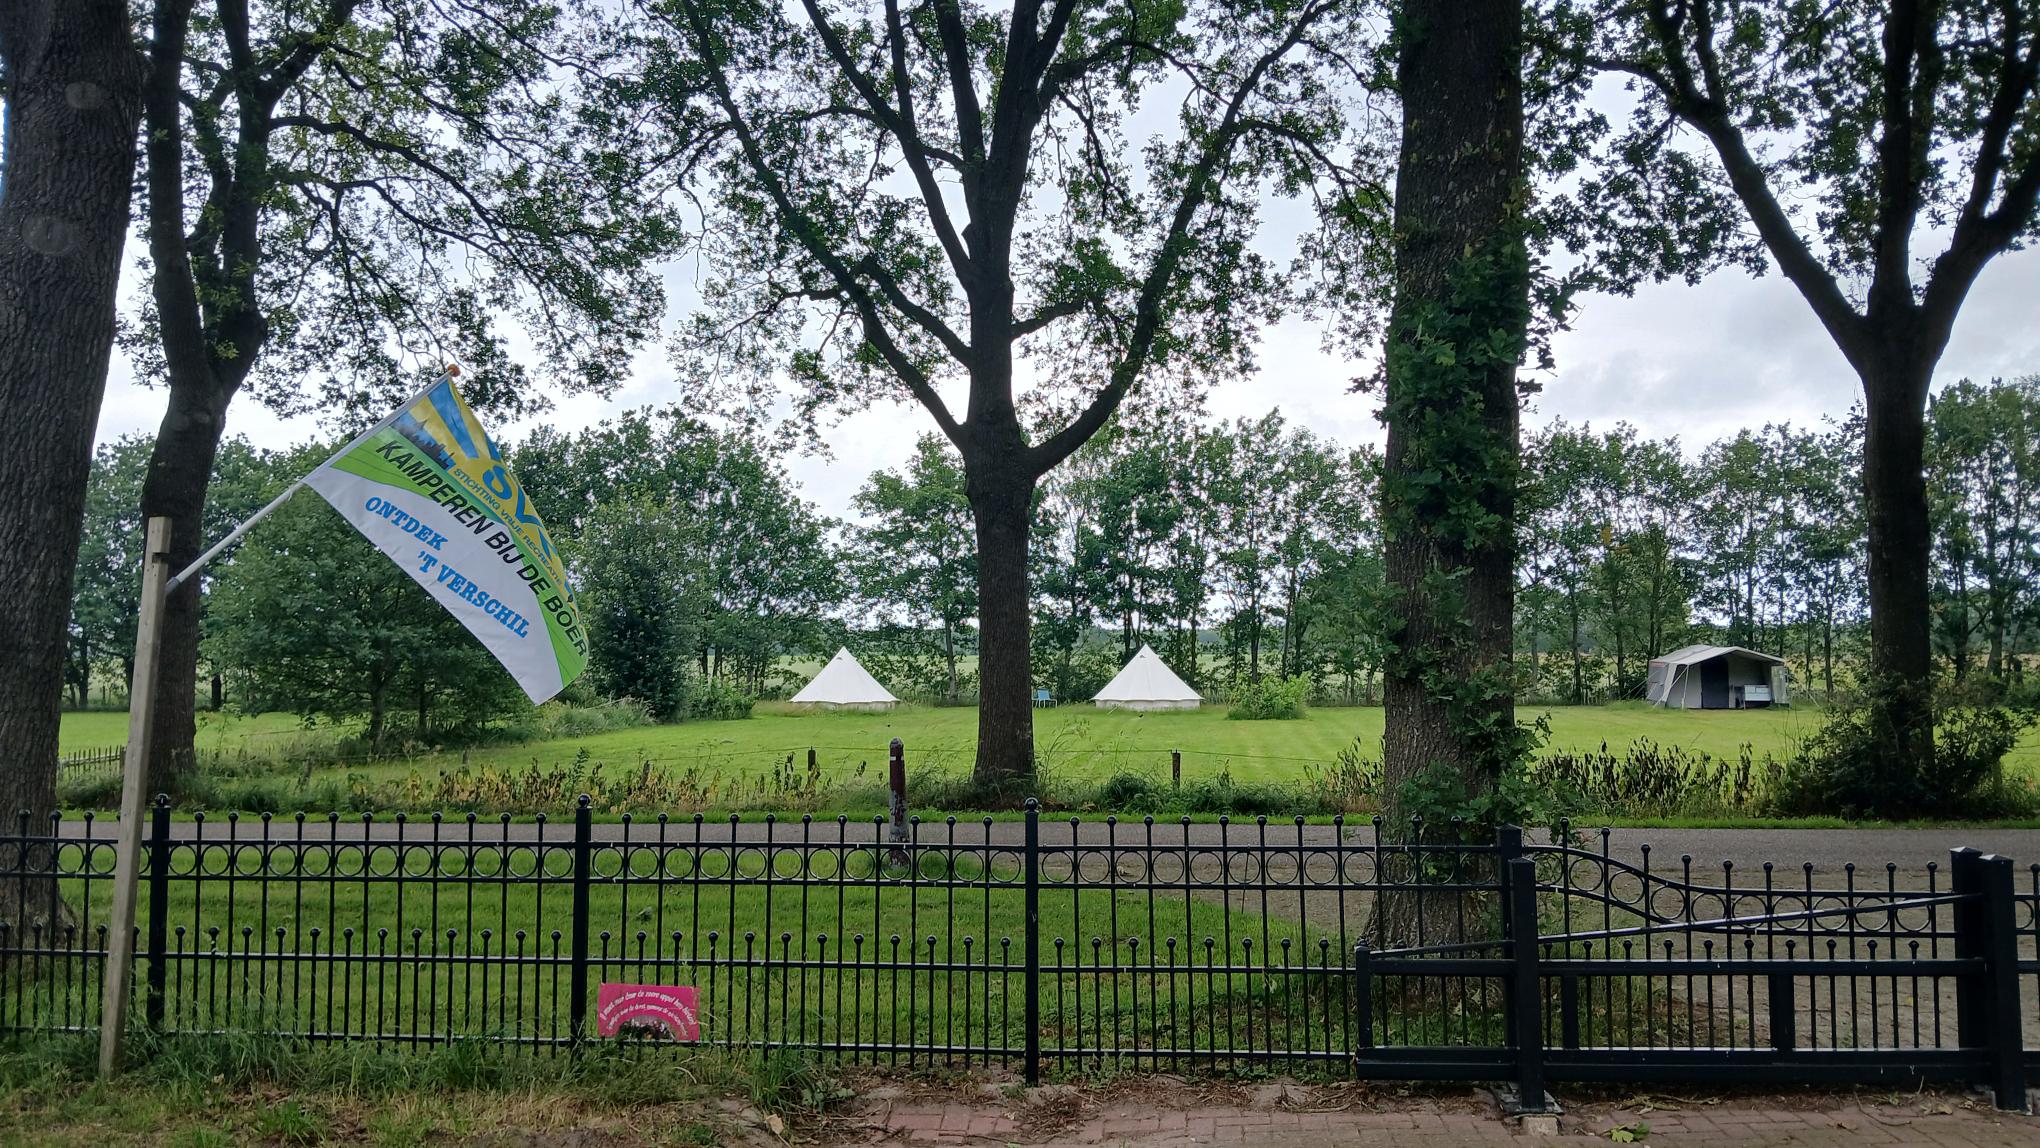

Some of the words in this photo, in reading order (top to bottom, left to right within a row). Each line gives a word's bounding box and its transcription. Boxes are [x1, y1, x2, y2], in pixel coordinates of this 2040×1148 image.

[365, 496, 449, 552] ONTDEK
[454, 469, 500, 510] STICHTING
[501, 509, 525, 536] VRIJE
[376, 439, 495, 535] KAMPEREN
[484, 531, 525, 564] BIJ
[516, 564, 551, 595] DE
[543, 595, 587, 657] BOER
[437, 566, 530, 639] VERSCHIL
